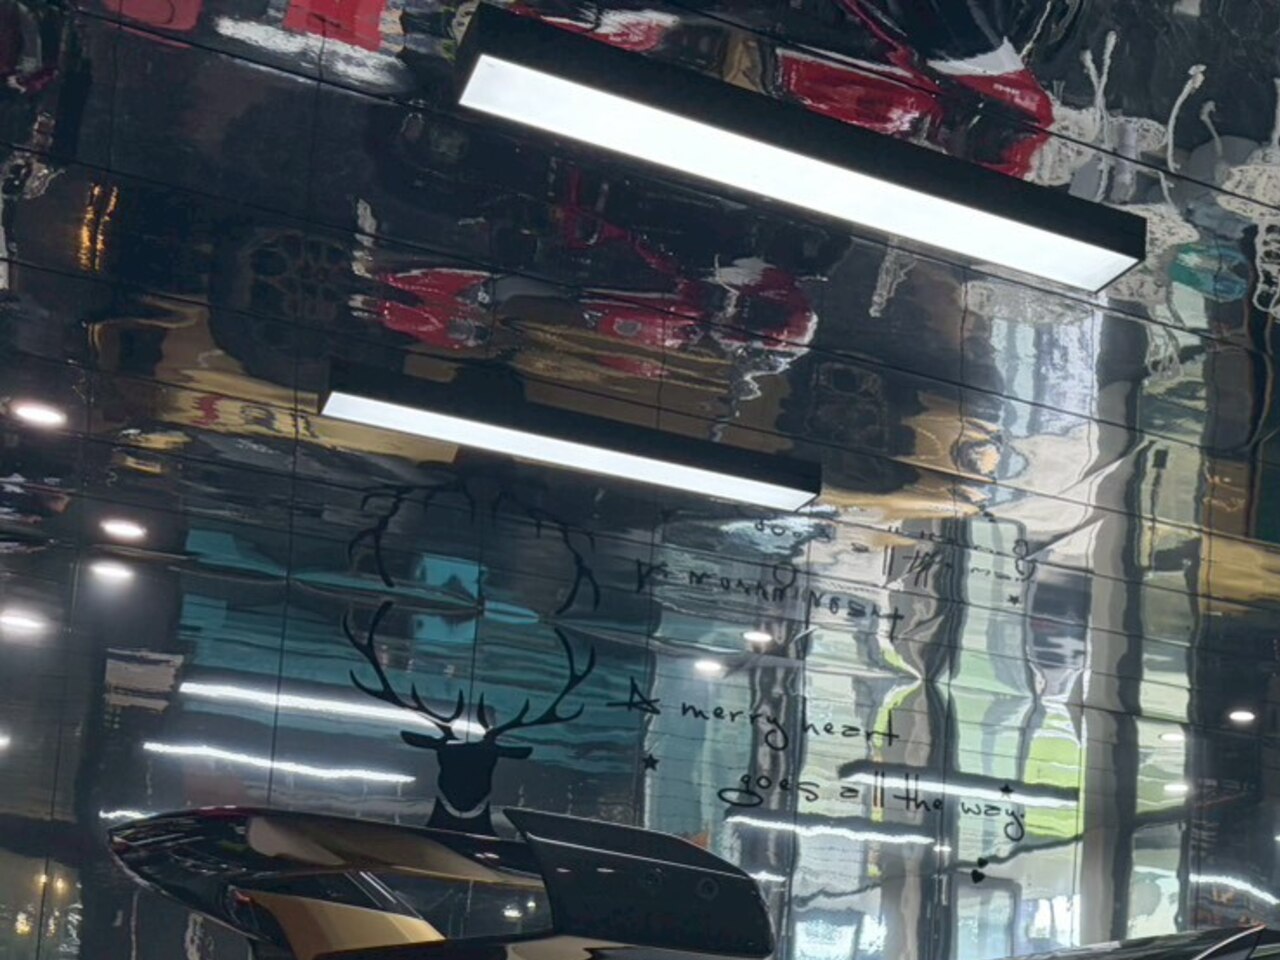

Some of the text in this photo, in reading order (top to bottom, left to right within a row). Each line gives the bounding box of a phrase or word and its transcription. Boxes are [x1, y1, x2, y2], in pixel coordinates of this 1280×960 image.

[606, 677, 899, 750] A merry heart
[718, 774, 819, 807] goes
[839, 770, 885, 808] all
[893, 773, 944, 811] the
